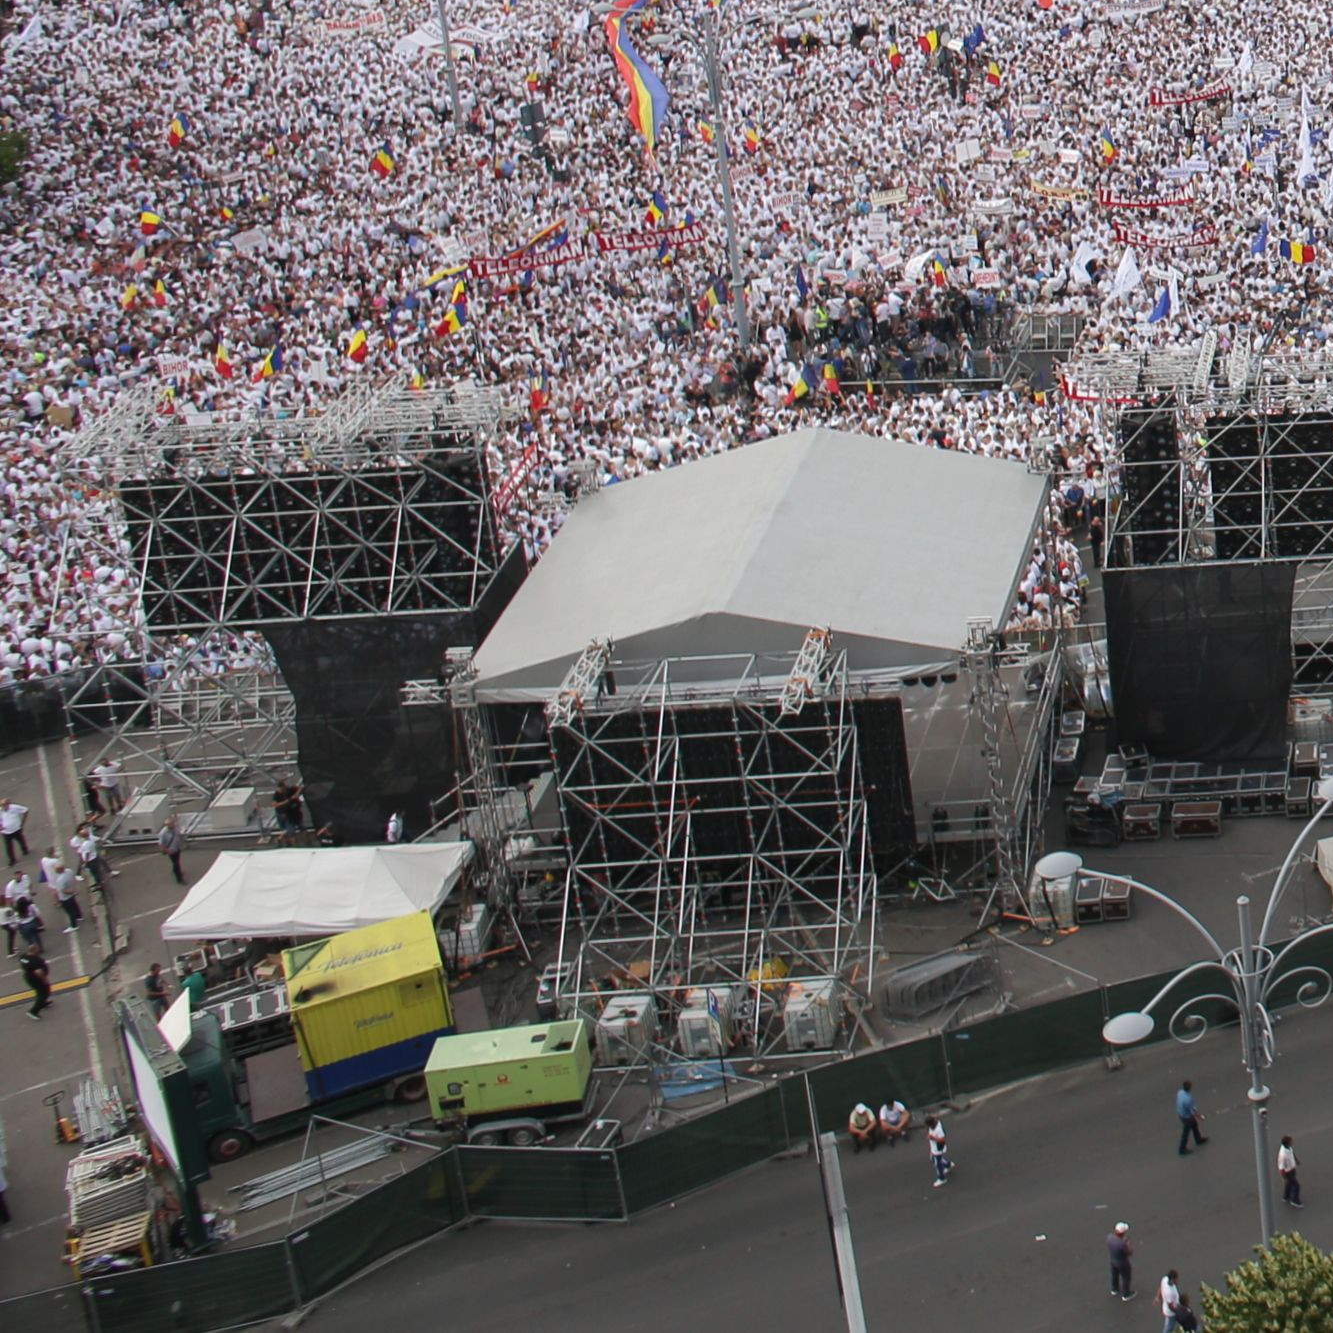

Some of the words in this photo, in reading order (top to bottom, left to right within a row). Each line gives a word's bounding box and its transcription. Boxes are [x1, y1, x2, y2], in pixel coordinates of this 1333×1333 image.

[602, 223, 704, 250] TELEORMAN
[473, 240, 584, 276] TELEORMAN
[162, 360, 189, 375] BIHOR
